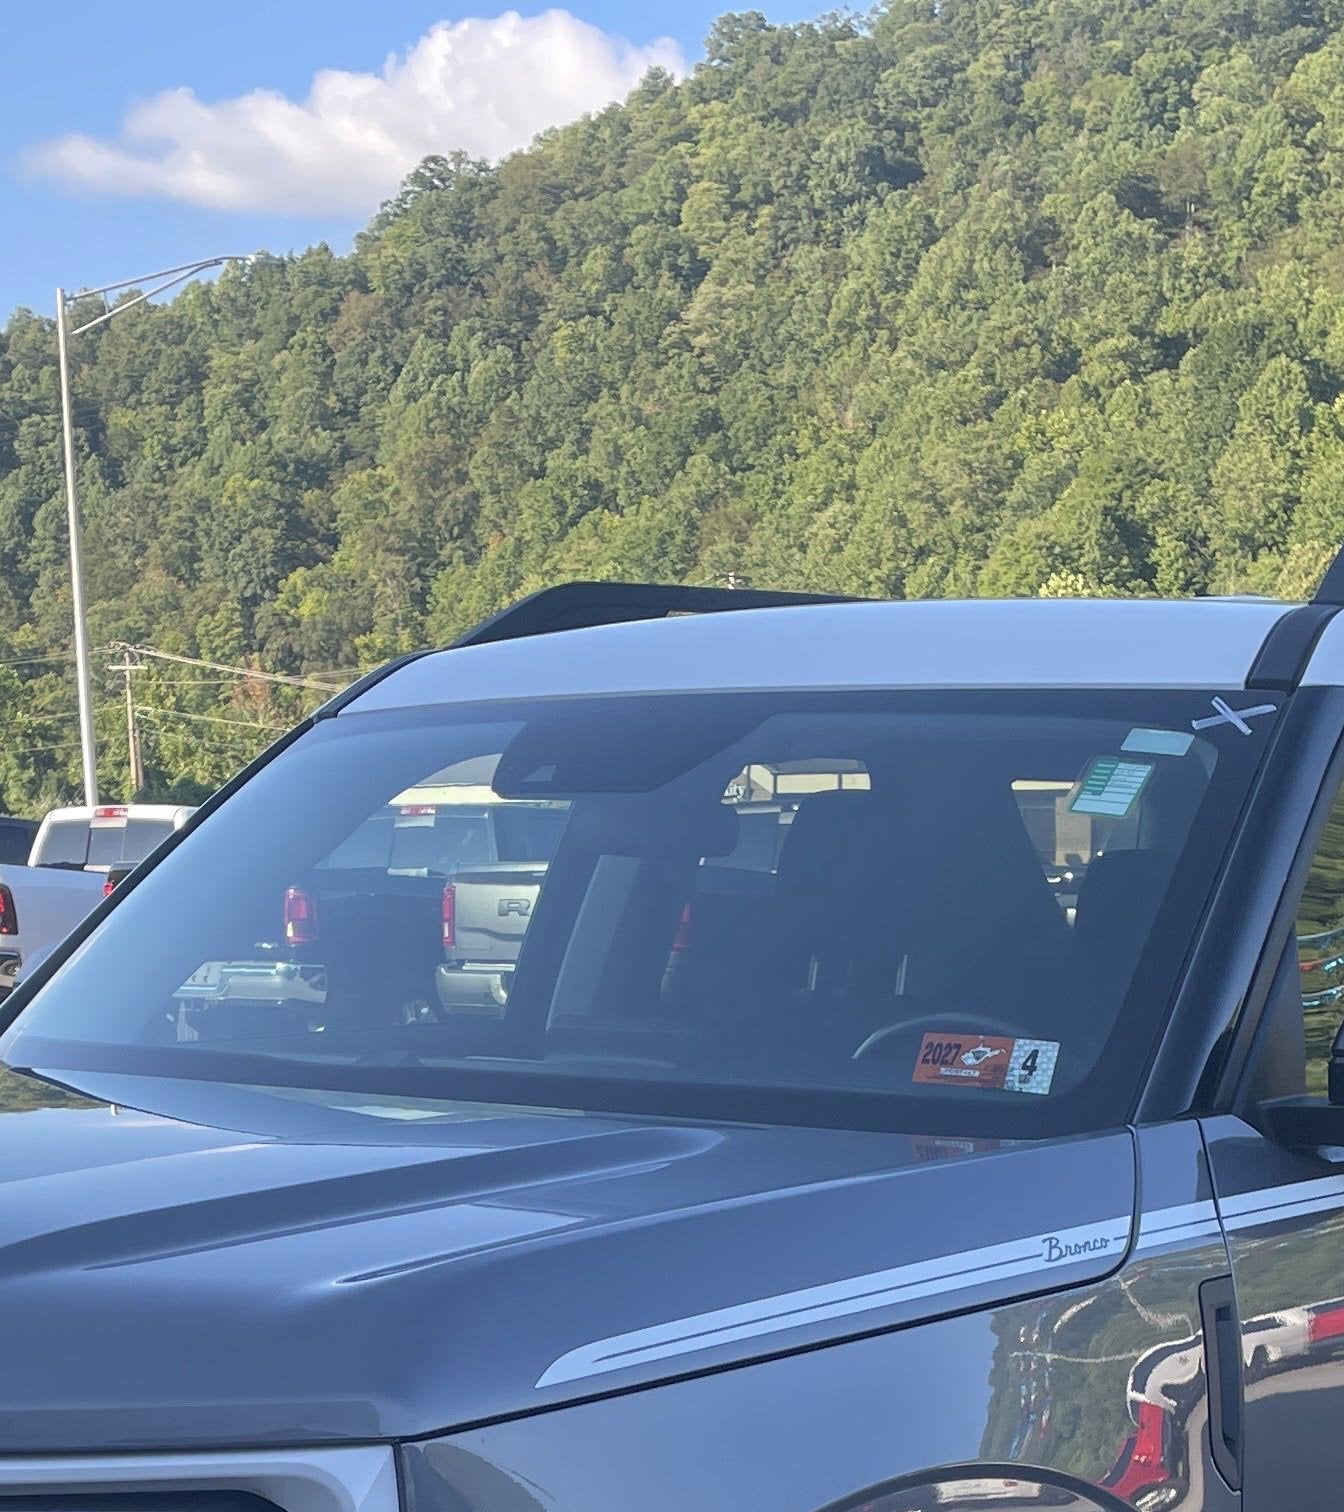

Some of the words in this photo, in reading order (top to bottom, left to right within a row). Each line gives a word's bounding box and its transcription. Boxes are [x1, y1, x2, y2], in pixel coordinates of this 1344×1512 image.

[921, 1041, 961, 1066] 2027
[1021, 1048, 1040, 1077] 4
[1041, 1236, 1111, 1262] Bronco
